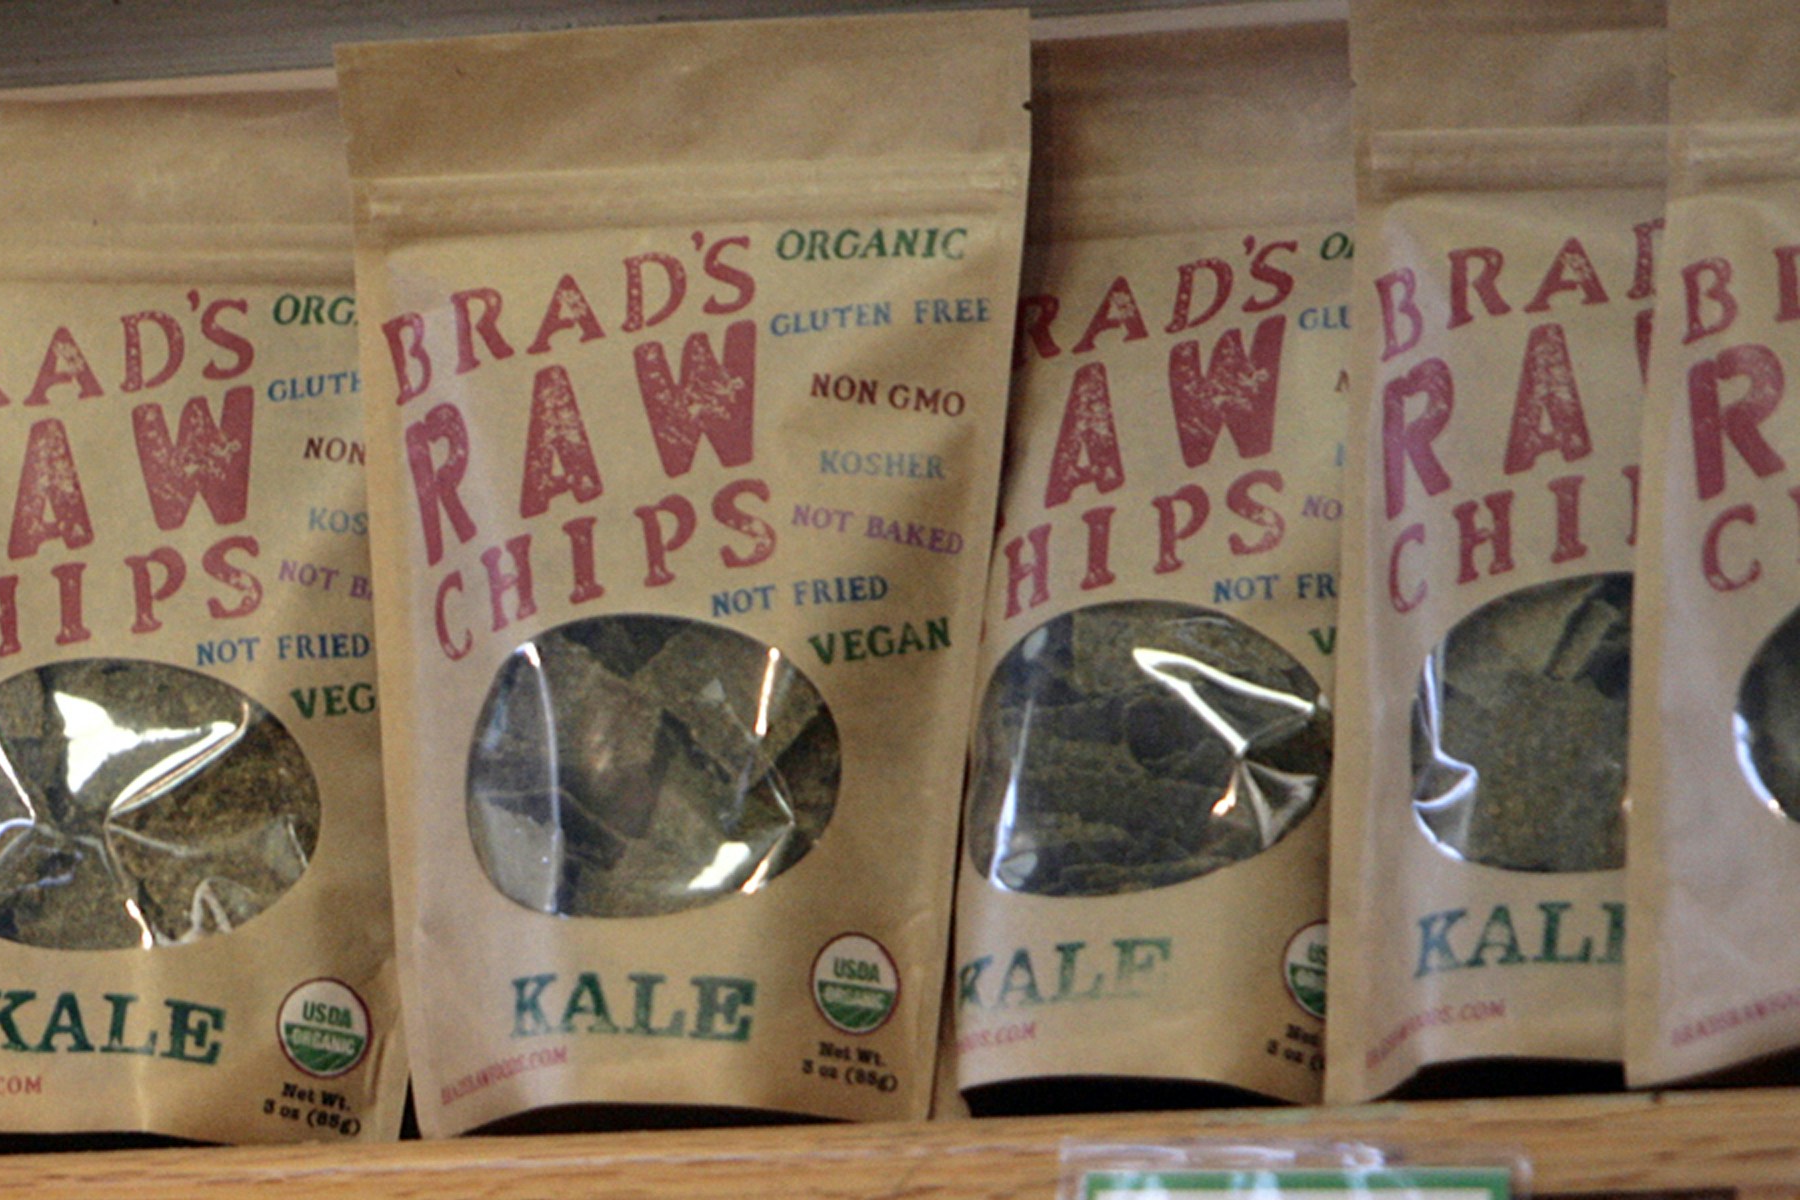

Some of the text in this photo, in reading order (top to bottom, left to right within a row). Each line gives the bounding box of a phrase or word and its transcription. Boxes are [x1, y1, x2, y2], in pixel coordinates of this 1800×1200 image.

[775, 227, 968, 262] ORGANIC
[273, 293, 358, 326] ORG
[381, 230, 757, 406] BRAD'S
[770, 298, 991, 337] GLUTEN FREE
[810, 372, 966, 418] NON GMO
[1382, 307, 1656, 521] RA
[405, 319, 757, 567] RAW
[819, 449, 947, 481] KOSHER
[792, 504, 965, 556] NOT BAKED
[278, 560, 339, 591] NOT
[435, 478, 777, 661] CHIPS
[1213, 574, 1280, 604] NOT
[711, 575, 889, 618] NOT FRIED
[196, 633, 370, 666] NOT FRIED
[808, 616, 952, 666] VEGAN
[833, 957, 881, 983] USDA
[302, 1000, 353, 1029] USDA
[510, 971, 758, 1043] KALE
[282, 1082, 315, 1103] Net
